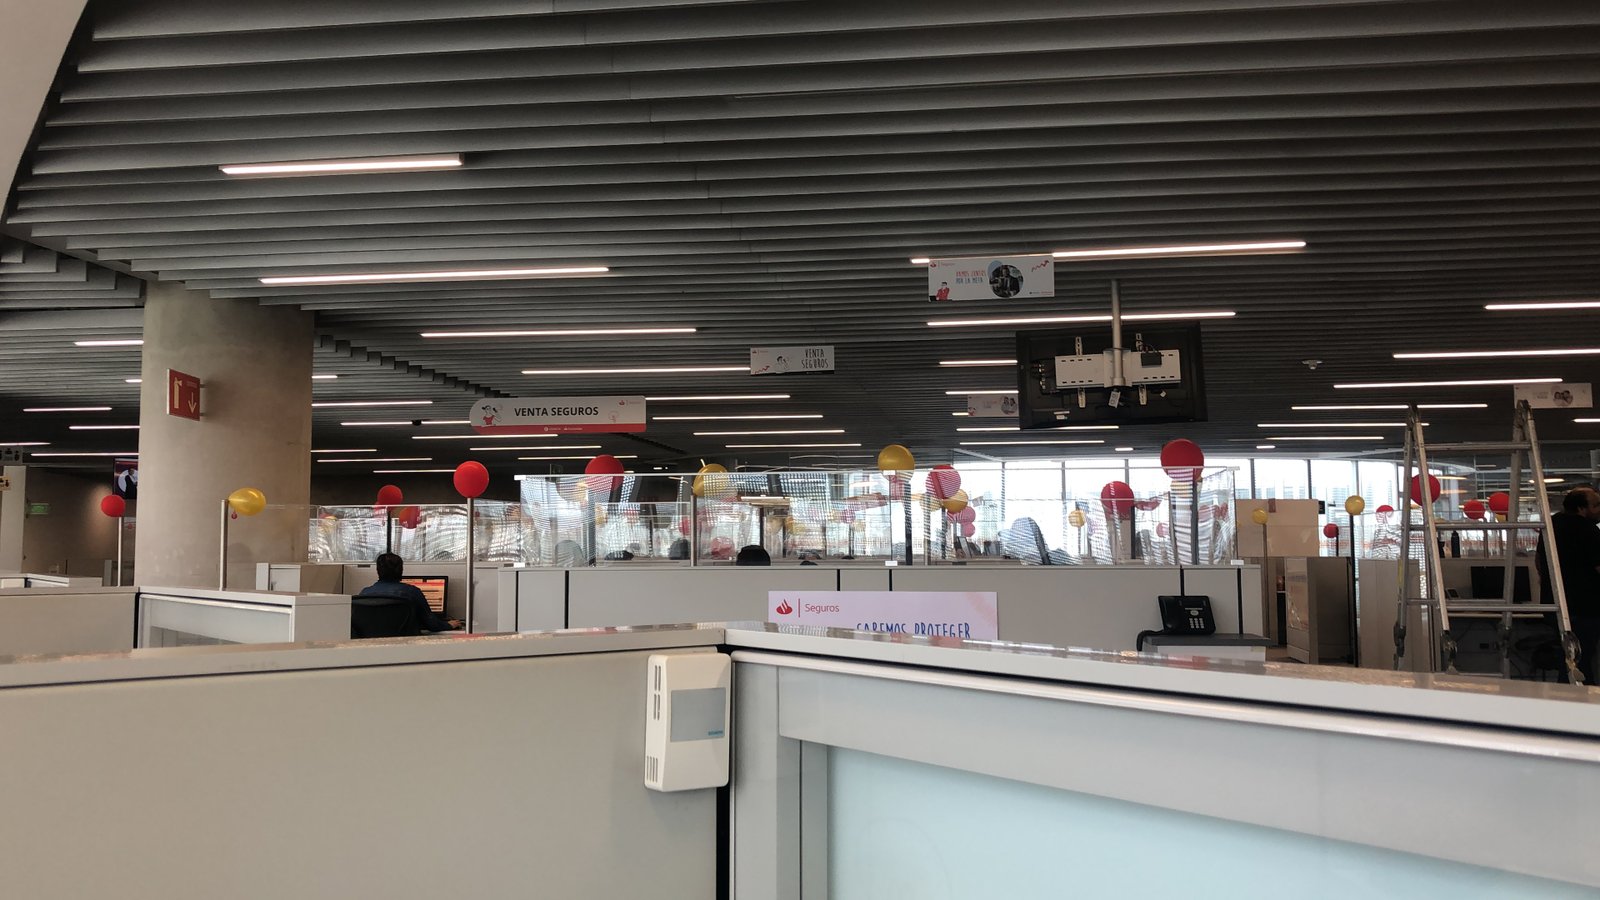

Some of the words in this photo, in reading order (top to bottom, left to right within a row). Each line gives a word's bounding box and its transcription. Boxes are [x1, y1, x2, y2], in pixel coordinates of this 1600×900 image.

[805, 348, 825, 358] VENTA
[801, 358, 829, 369] SEGUROS
[514, 407, 548, 417] VENTA
[551, 406, 599, 416] SEGUROS
[805, 603, 840, 614] Seguros
[914, 622, 970, 639] PROTEGER
